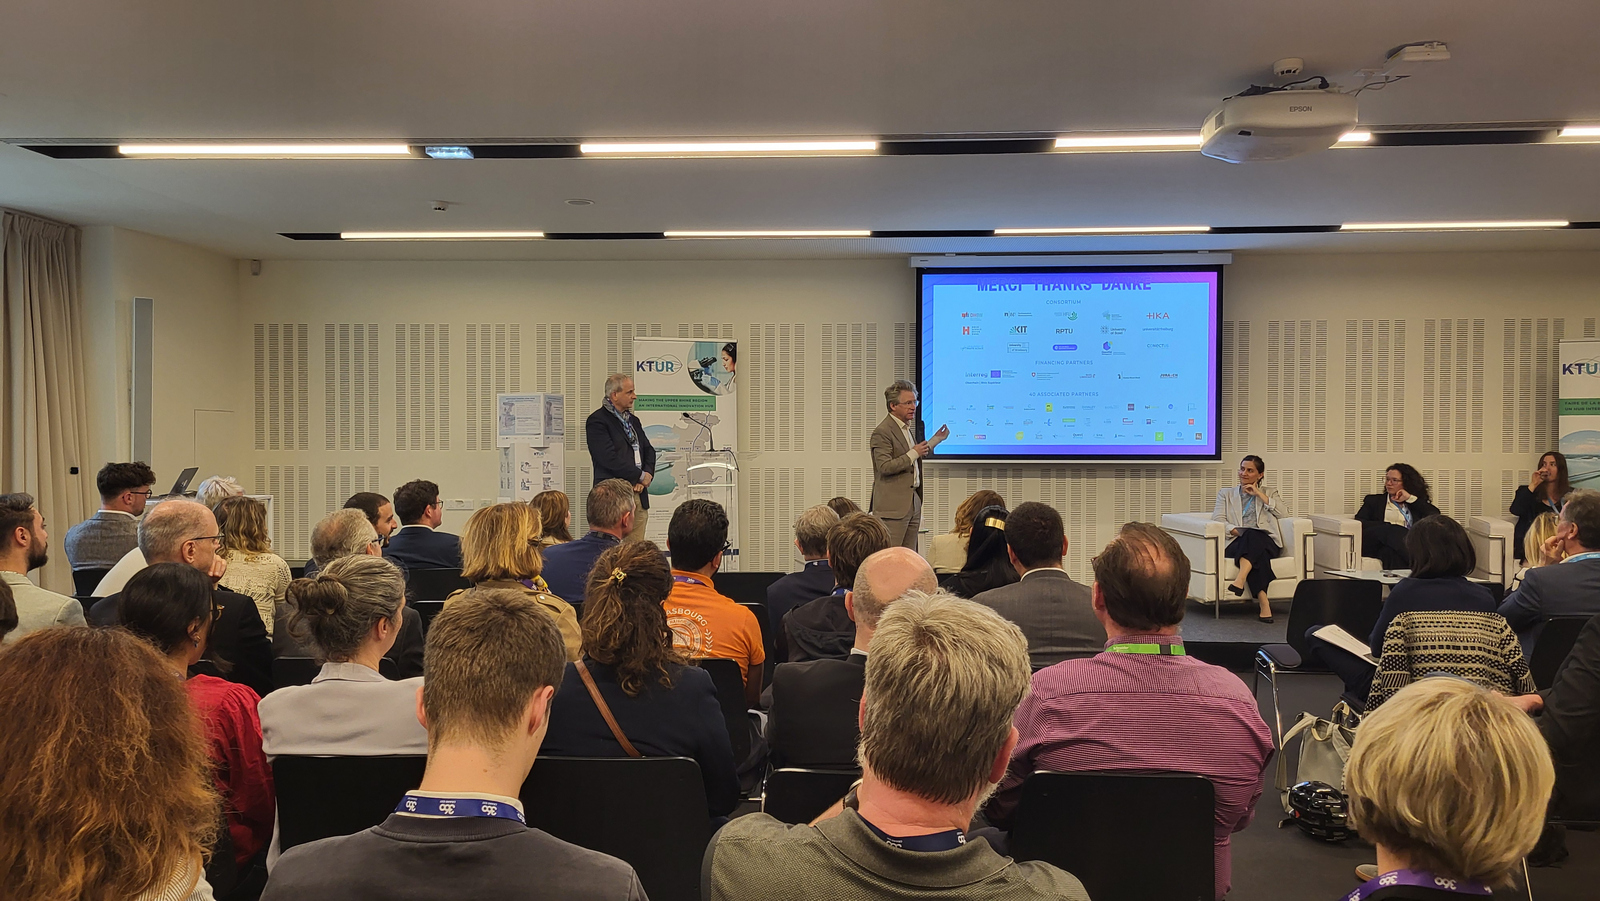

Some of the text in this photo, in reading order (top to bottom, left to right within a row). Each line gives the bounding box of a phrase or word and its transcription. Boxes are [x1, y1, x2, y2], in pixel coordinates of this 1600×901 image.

[977, 277, 1152, 292] MERCI THANKS DANKE
[636, 360, 674, 372] KTUR
[1562, 363, 1600, 375] KTU
[666, 608, 708, 626] ASBOURG
[439, 804, 456, 815] 360
[481, 805, 498, 816] 360
[1379, 875, 1398, 886] 360
[1434, 876, 1457, 890] 360
